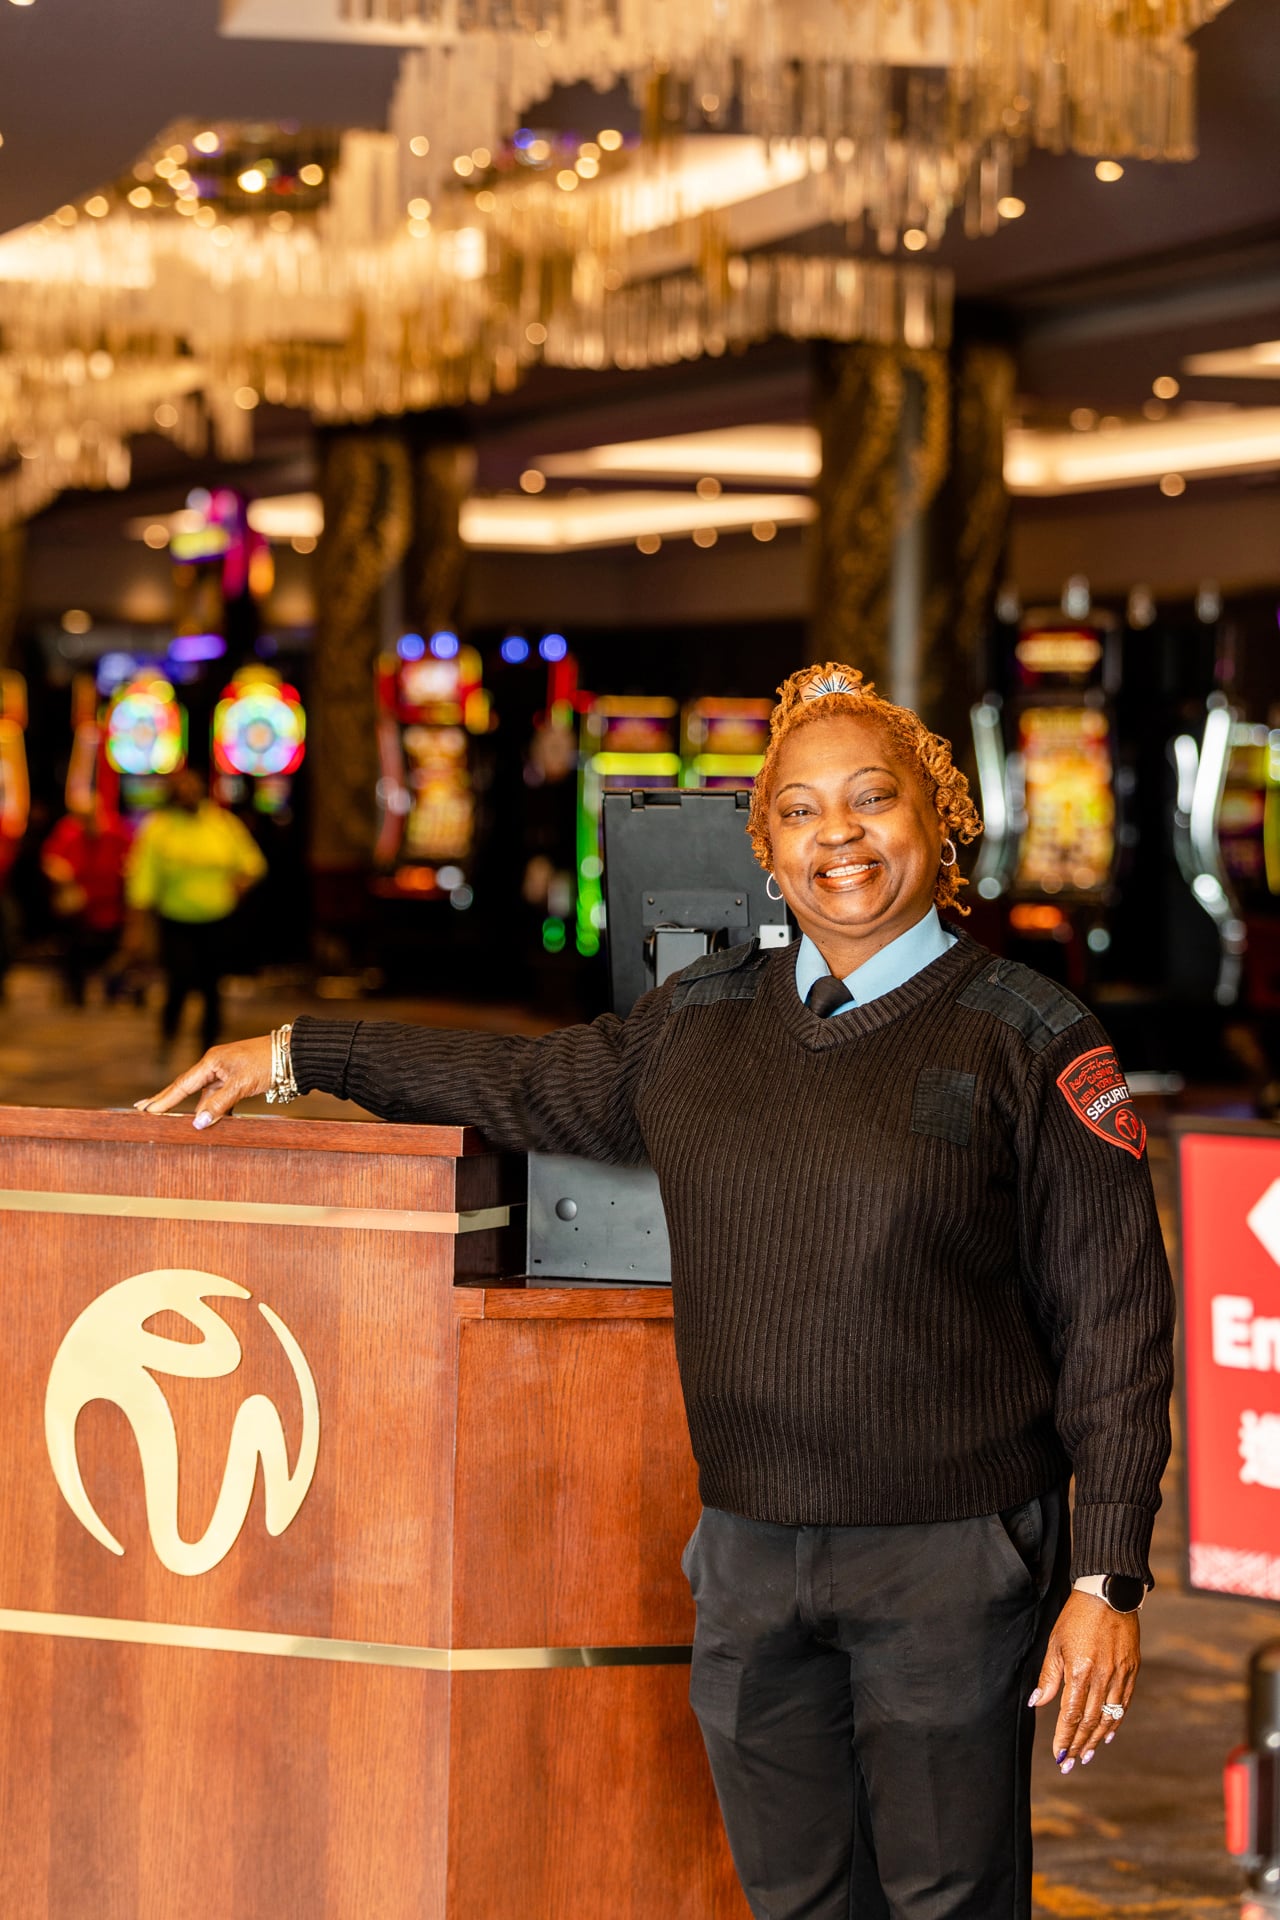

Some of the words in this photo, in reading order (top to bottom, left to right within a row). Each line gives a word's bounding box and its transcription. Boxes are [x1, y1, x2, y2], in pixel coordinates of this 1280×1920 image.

[1078, 1086, 1097, 1106] NEW
[1094, 1075, 1115, 1090] YORK
[1086, 1066, 1114, 1085] CASINO
[1086, 1086, 1129, 1121] SECURIT
[1211, 1295, 1280, 1373] En
